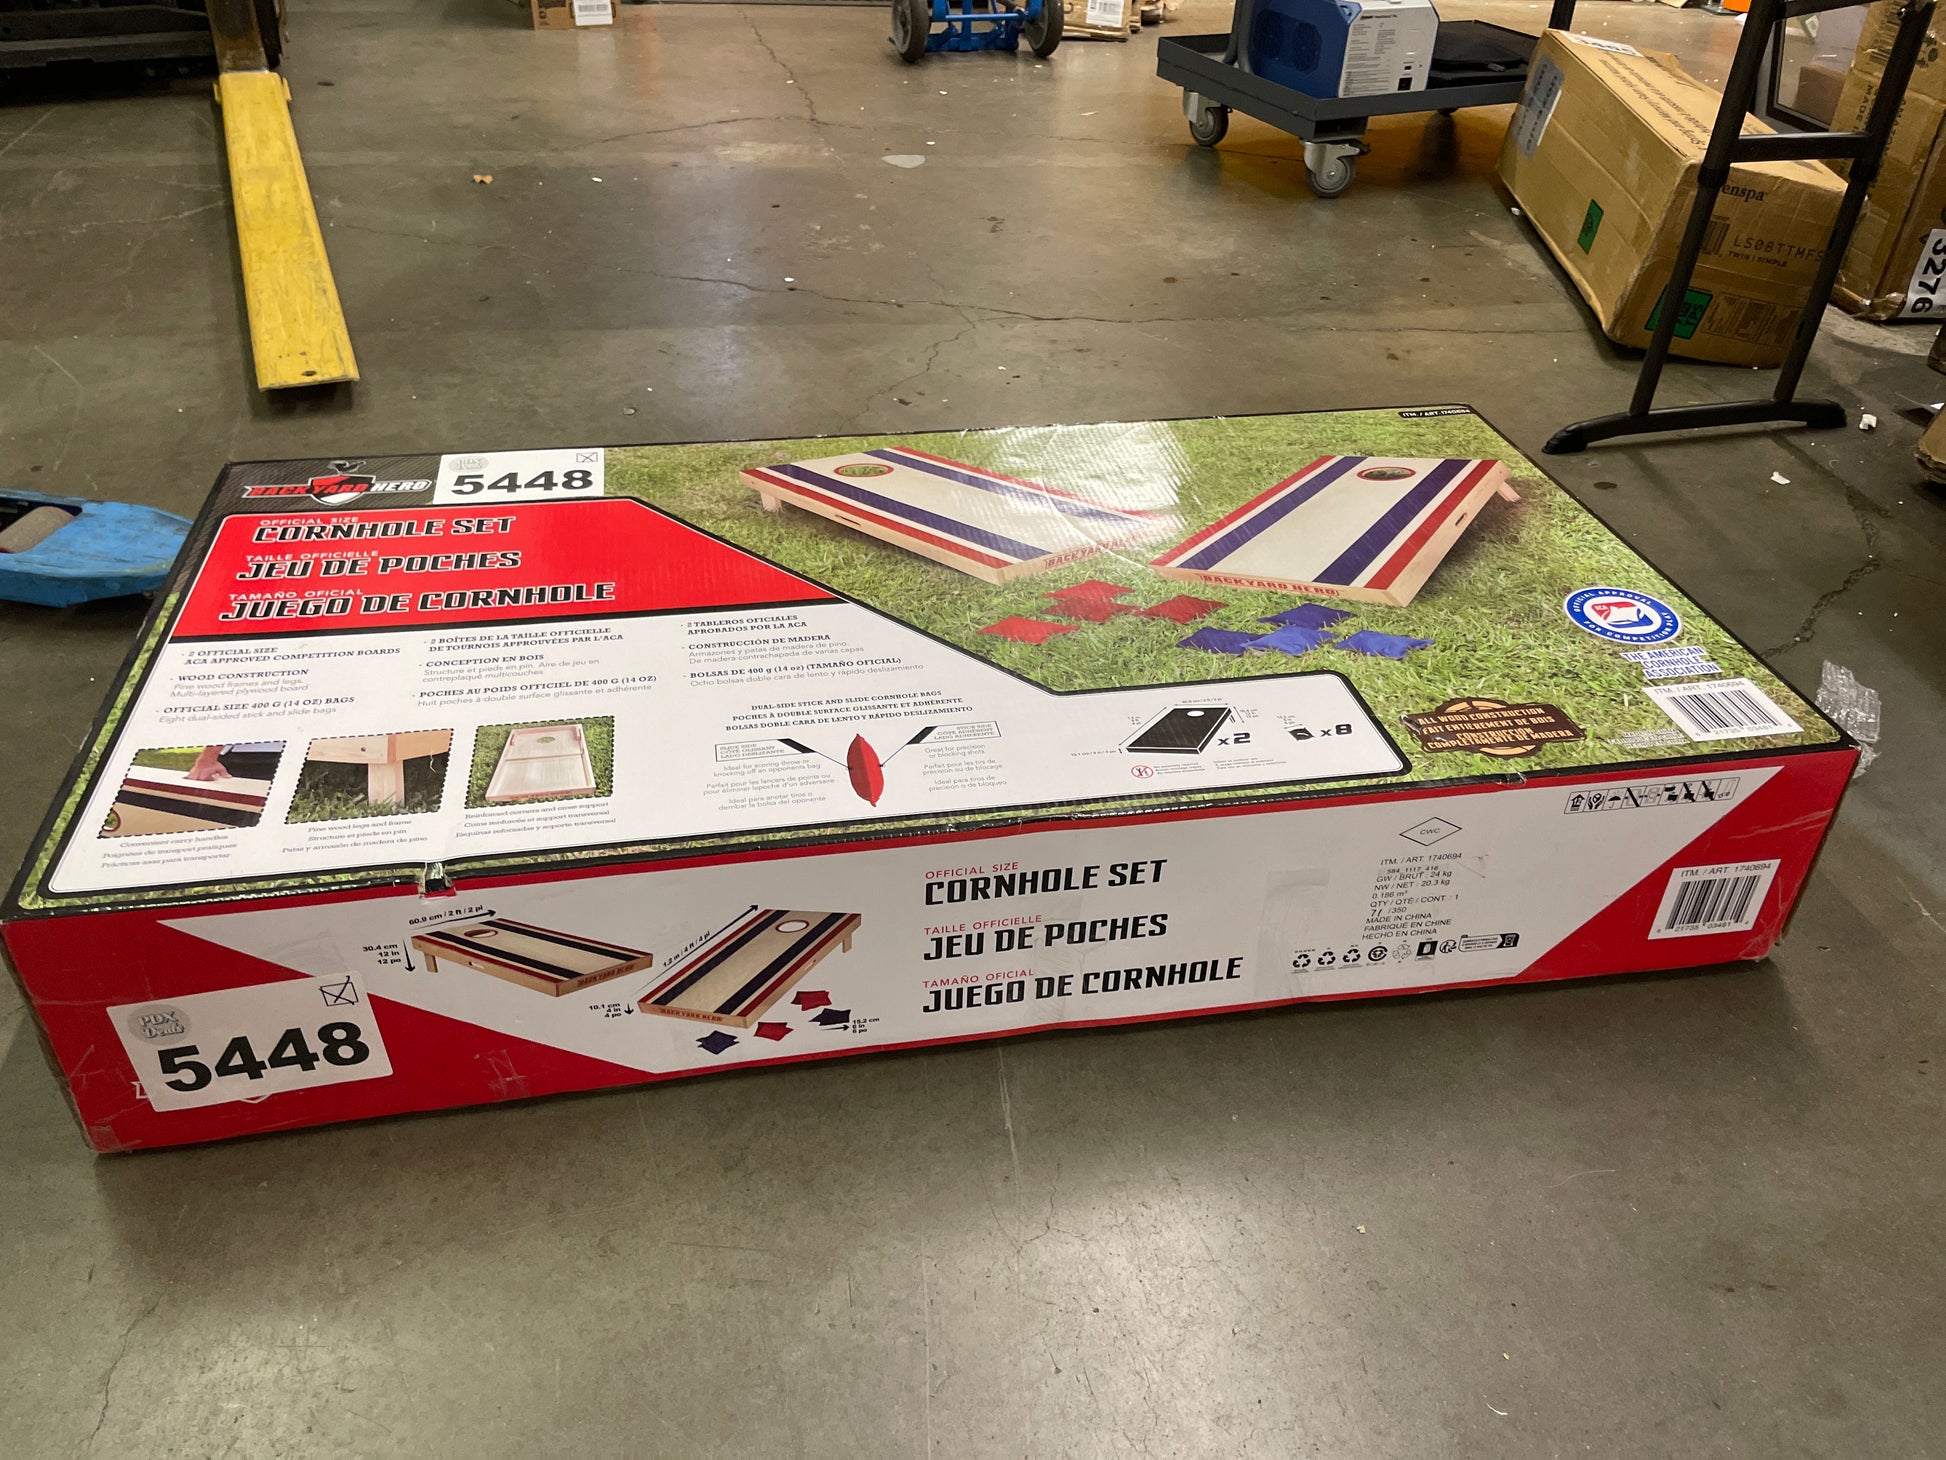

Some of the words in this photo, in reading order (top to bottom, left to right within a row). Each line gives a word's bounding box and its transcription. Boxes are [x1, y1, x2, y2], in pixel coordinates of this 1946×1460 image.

[1720, 184, 1765, 202] enspa
[1728, 250, 1749, 260] TWIN
[369, 481, 428, 492] HERO
[451, 469, 593, 495] 5448
[259, 518, 323, 526] OFFICIAL
[330, 516, 359, 524] SIZE
[252, 519, 446, 544] CORNHOLE
[451, 516, 517, 535] SET
[245, 553, 294, 562] TAILLE
[300, 550, 379, 559] OFFICIELLE
[236, 559, 315, 580] JEU
[319, 557, 372, 577] DE
[378, 550, 522, 575] POCHES
[218, 597, 354, 622] JUEGO
[360, 593, 413, 615] DE
[417, 582, 616, 612] CORNHOLE
[228, 590, 297, 601] TAMAÑO
[304, 588, 364, 597] OFICIAL
[1573, 592, 1596, 613] OFFICIAL
[1598, 590, 1652, 605] APPROVAL
[693, 619, 745, 628] TABLEROS
[746, 615, 799, 623] OFICIALES
[1583, 620, 1602, 632] FOR
[1606, 627, 1673, 642] COMPETITION
[1661, 612, 1674, 627] PLAY
[495, 633, 509, 641] LA
[510, 631, 548, 640] TAILLE
[549, 627, 611, 637] OFFICIELLE
[687, 626, 748, 635] APROBADOS
[445, 642, 502, 652] TOURNOIS
[688, 638, 770, 650] CONSTRUCCIÓN
[788, 634, 831, 643] MADERA
[184, 658, 209, 666] ACA
[210, 655, 271, 665] APPROVED
[273, 651, 356, 661] COMPETITION
[357, 647, 401, 656] BOARDS
[197, 648, 252, 656] OFFICIAL
[1624, 652, 1646, 662] THE
[1647, 646, 1705, 660] AMERICAN
[426, 657, 500, 668] CONCEPTION
[519, 653, 545, 661] BOIS
[690, 670, 729, 679] BOLSAS
[856, 657, 902, 668] OFICIAL)
[1643, 656, 1704, 670] CORNHOLE
[178, 673, 215, 682] WOOD
[217, 668, 309, 680] CONSTRUCTION
[1644, 663, 1719, 679] ASSOCIATION
[418, 689, 465, 698] POCHES
[466, 687, 482, 695] AU
[483, 684, 518, 694] POIDS
[519, 681, 573, 691] OFFICIEL
[574, 679, 590, 688] DE
[591, 678, 609, 686] 400
[610, 677, 620, 685] G
[870, 692, 919, 701] CORNHOLE
[163, 704, 221, 714] OFFICIAL
[222, 702, 249, 711] SIZE
[251, 701, 270, 709] 400
[272, 700, 281, 708] G
[284, 699, 301, 708] (14
[302, 698, 323, 707] OZ)
[324, 696, 355, 704] BAGS
[1417, 716, 1438, 726] ALL
[1438, 714, 1469, 723] WOOD
[1468, 707, 1546, 721] CONSTRUCTION
[1422, 725, 1445, 735] FAIT
[1515, 718, 1530, 726] DE
[1528, 716, 1555, 724] BOIS
[1530, 730, 1574, 740] MADERA
[1419, 827, 1441, 835] CWC
[1380, 858, 1399, 866] ITM.
[1428, 852, 1462, 861] 1740694
[925, 865, 986, 880] OFFICIAL
[992, 861, 1020, 872] SIZE
[1680, 869, 1700, 878] ITM.
[1734, 862, 1772, 873] 1740694
[925, 865, 1101, 906] CORNHOLE
[1107, 859, 1168, 887] SET
[408, 916, 427, 925] 60.9
[924, 923, 967, 936] TAILLE
[972, 914, 1043, 931] OFFICIELLE
[1365, 915, 1392, 924] MADE
[1404, 912, 1432, 920] CHINA
[1425, 918, 1452, 927] CHINE
[923, 931, 985, 961] JEU
[994, 926, 1035, 953] DE
[1044, 913, 1169, 947] POCHES
[1361, 931, 1394, 940] HECHO
[1410, 928, 1437, 936] CHINA
[922, 979, 1025, 1014] JUEGO
[1034, 974, 1075, 1000] DE
[1081, 956, 1244, 995] CORNHOLE
[923, 974, 980, 989] TAMAÑO
[985, 969, 1035, 981] OFICIAL
[138, 1010, 180, 1027] PDX
[157, 1021, 370, 1092] 5448
